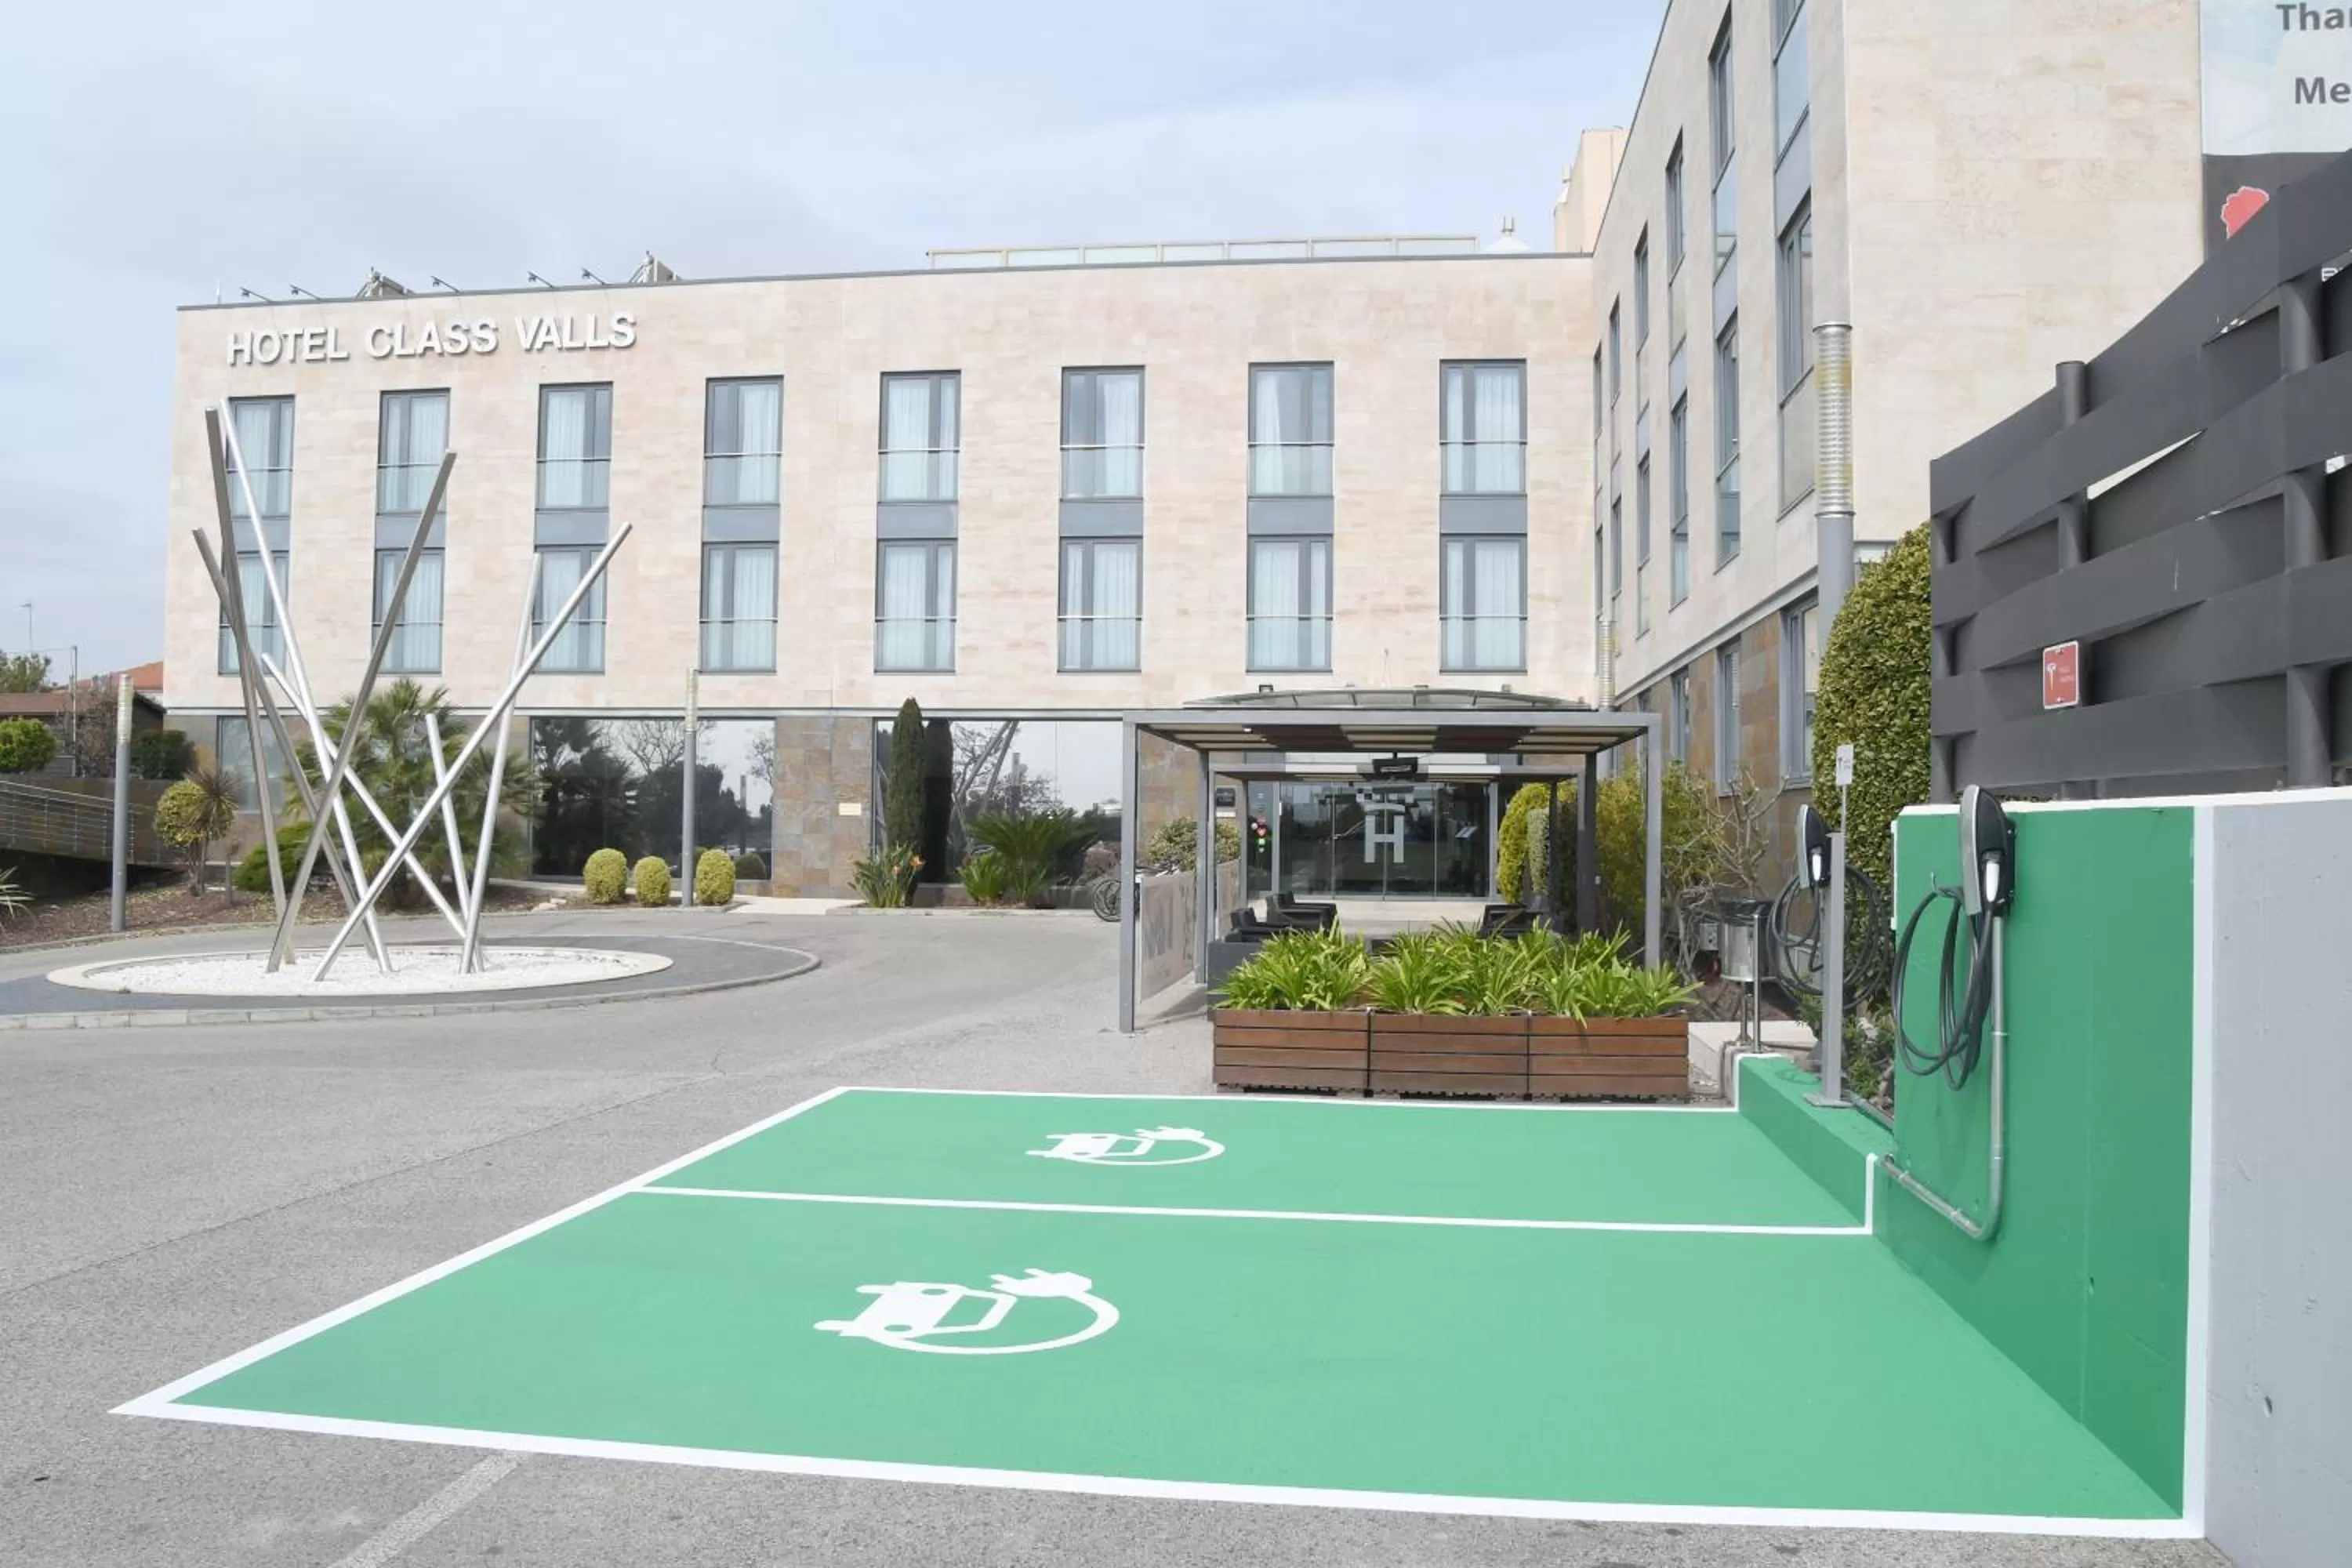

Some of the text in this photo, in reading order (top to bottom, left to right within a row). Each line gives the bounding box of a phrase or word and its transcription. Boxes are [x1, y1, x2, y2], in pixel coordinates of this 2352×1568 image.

[2275, 2, 2352, 31] Tha
[2294, 76, 2352, 104] Me
[227, 312, 637, 367] HOTEL CLASS VALLS
